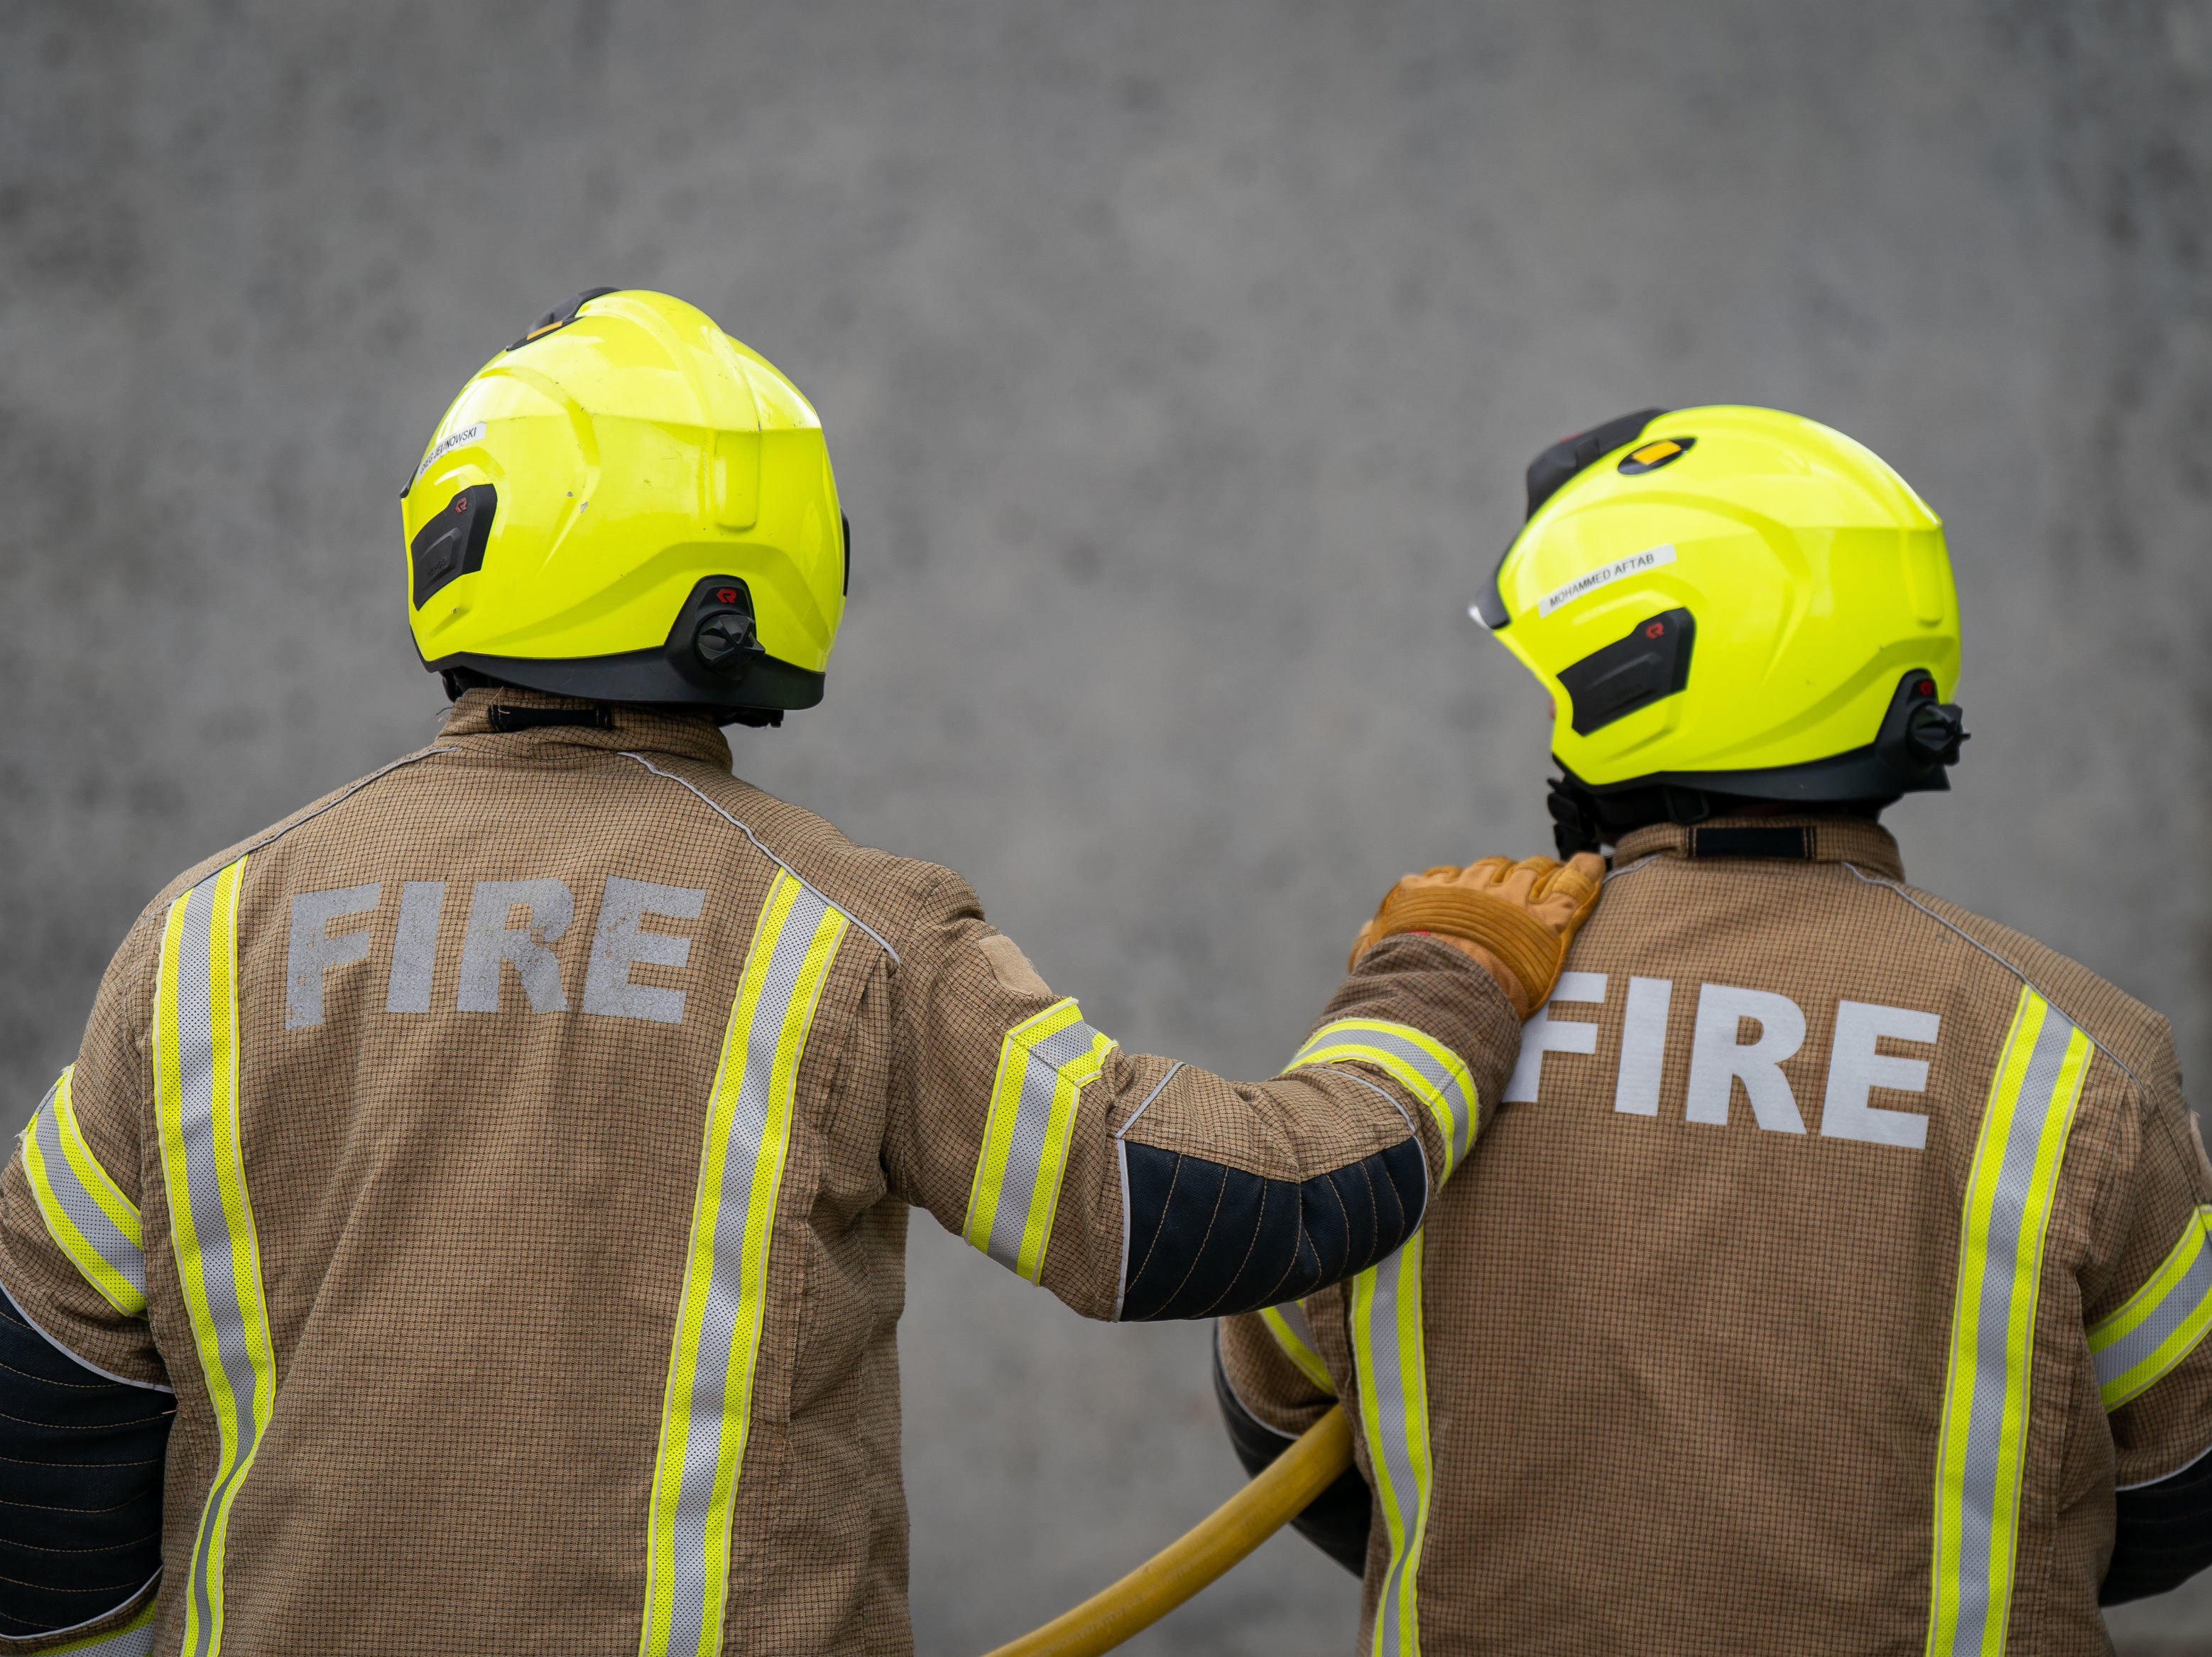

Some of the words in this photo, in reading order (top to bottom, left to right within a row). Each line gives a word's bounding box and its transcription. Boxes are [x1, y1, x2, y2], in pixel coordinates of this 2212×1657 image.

[1549, 568, 1611, 607] MOHAMMED
[1614, 553, 1655, 576] AFTAB
[285, 876, 707, 1030] FIRE
[1501, 971, 1941, 1150] FIRE
